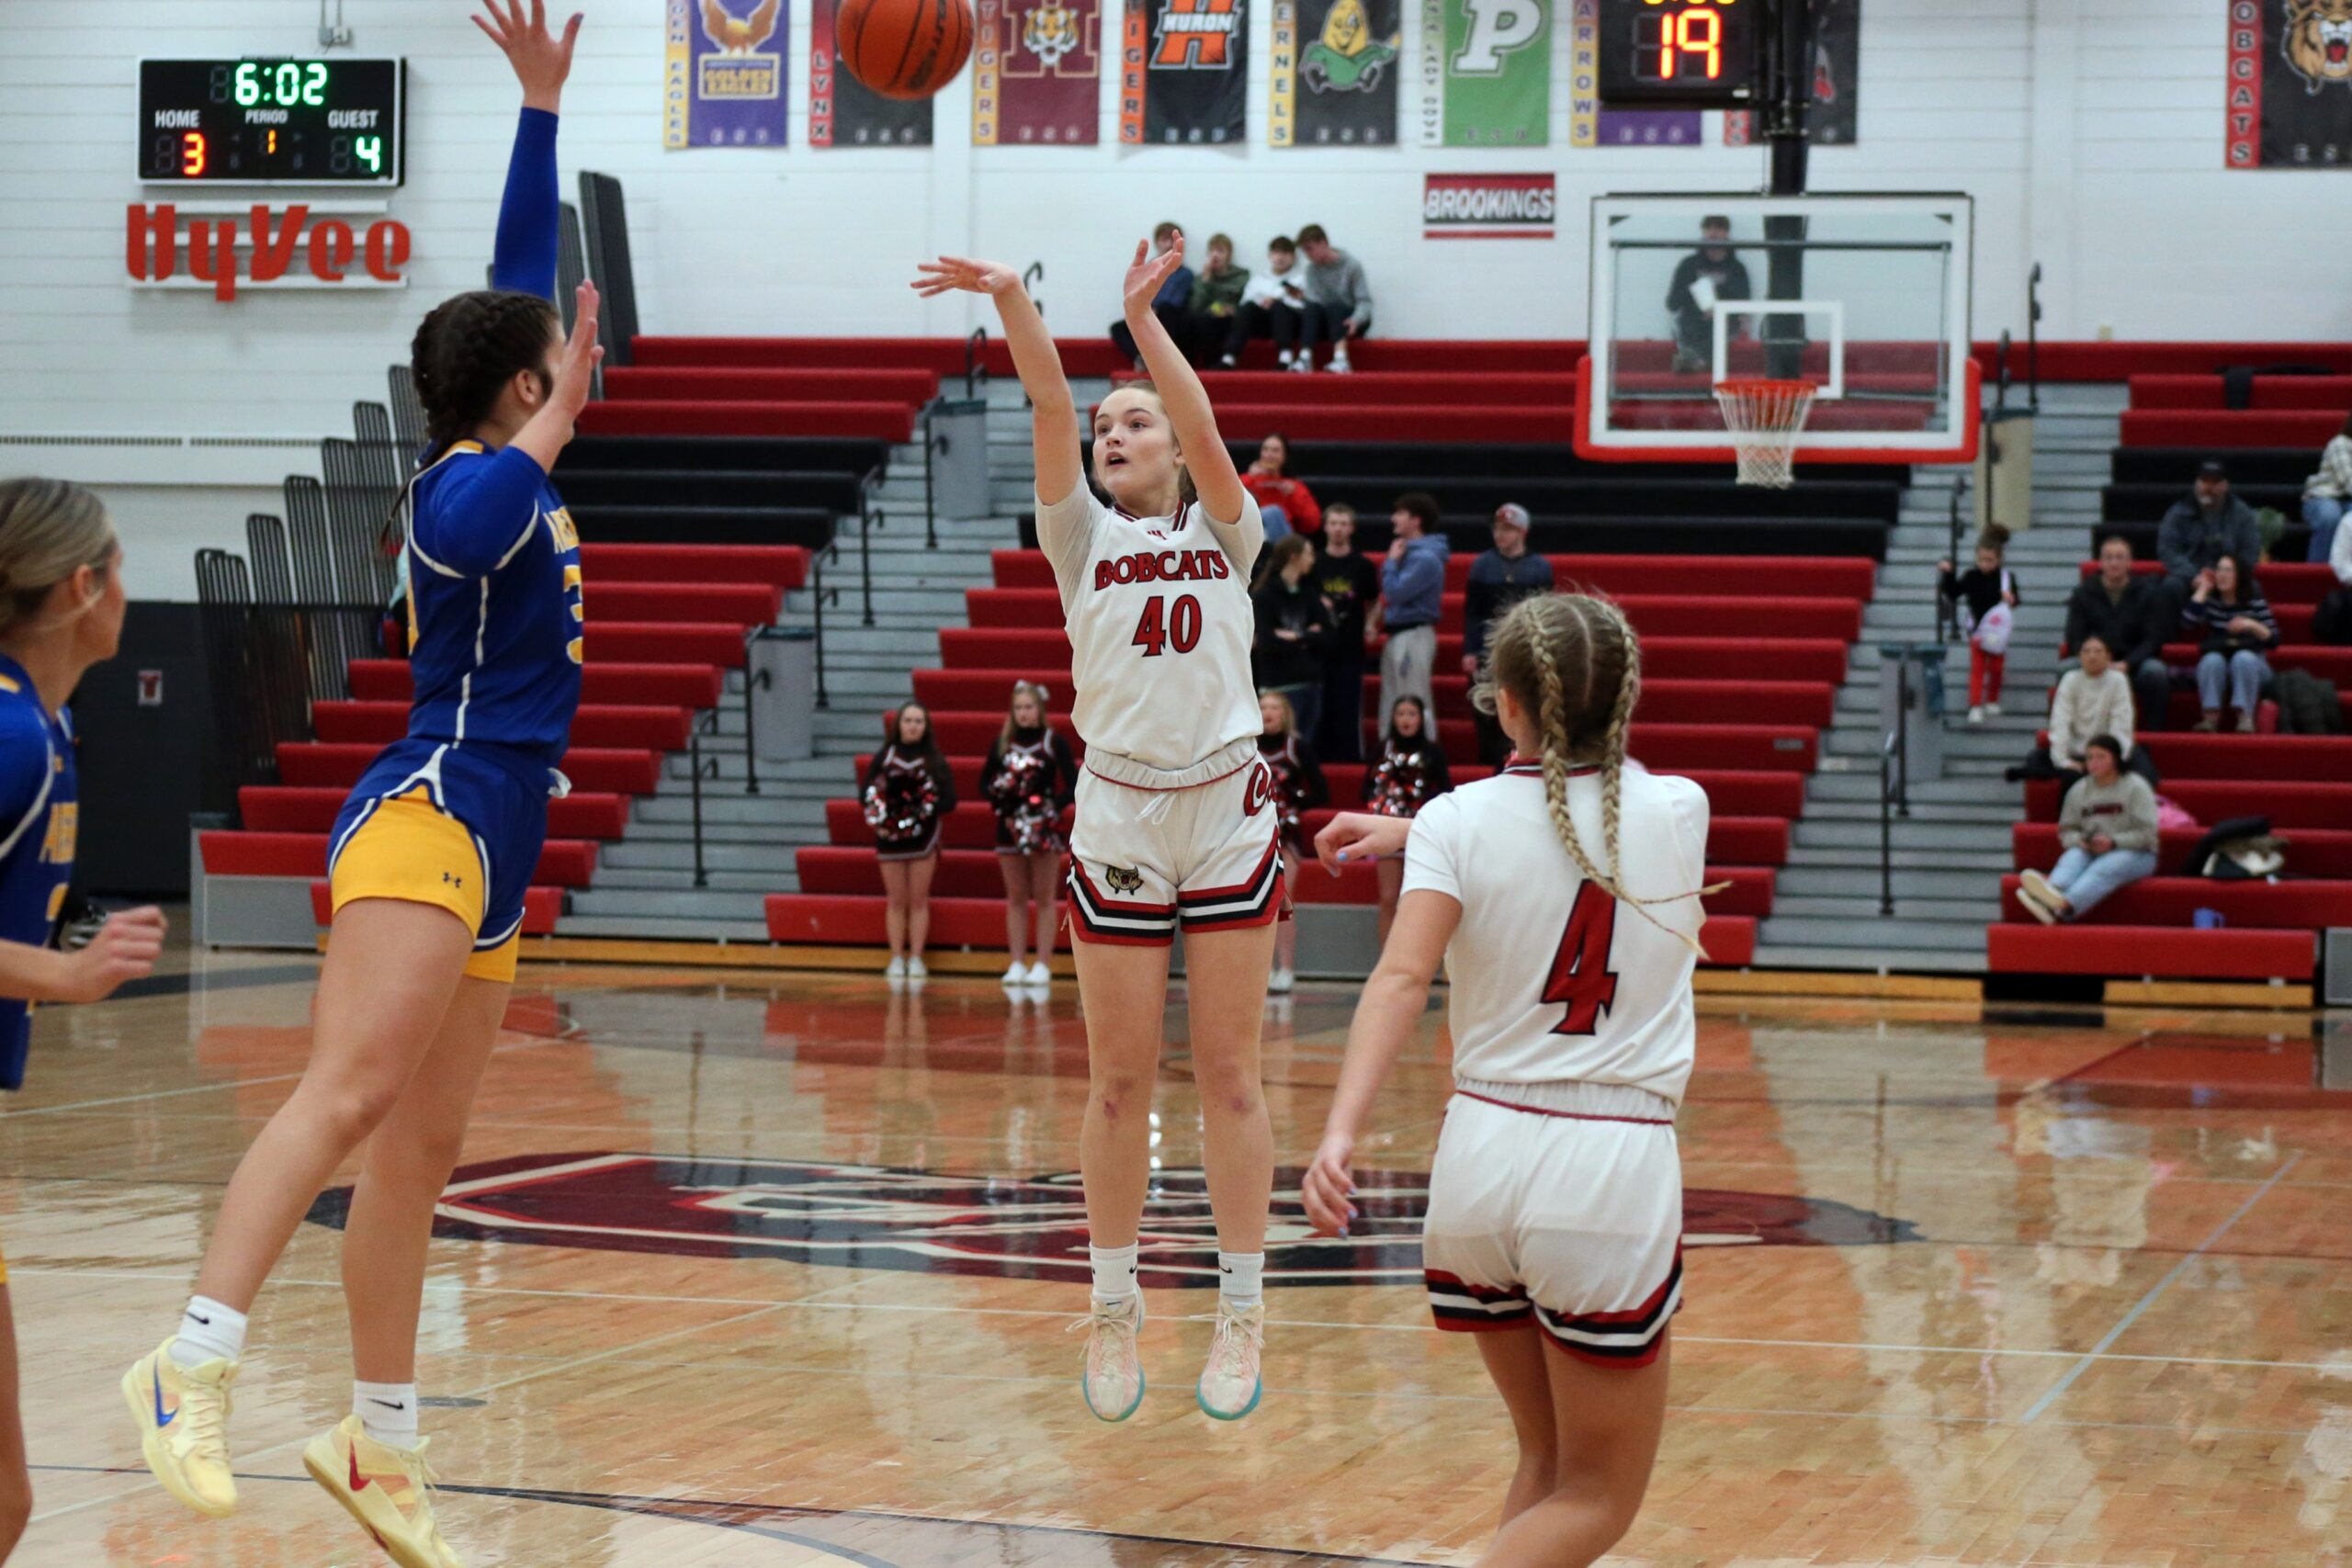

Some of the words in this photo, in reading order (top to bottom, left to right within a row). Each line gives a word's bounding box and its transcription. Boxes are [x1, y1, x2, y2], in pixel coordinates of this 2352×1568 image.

[1161, 13, 1233, 32] HURON
[1659, 8, 1721, 79] 19
[234, 62, 328, 106] 6:02
[978, 1, 996, 138] TIGERS
[1574, 4, 1592, 138] ARROWS
[244, 108, 289, 125] PERIOD
[812, 51, 829, 139] LYNX
[154, 109, 200, 129] HOME
[327, 109, 379, 130] GUEST
[183, 131, 207, 175] 3
[267, 129, 277, 154] 1
[355, 135, 381, 173] 4
[1425, 187, 1554, 220] BROOKINGS
[1094, 549, 1229, 591] BOBCATS
[1132, 593, 1202, 658] 40
[1539, 876, 1619, 1035] 4
